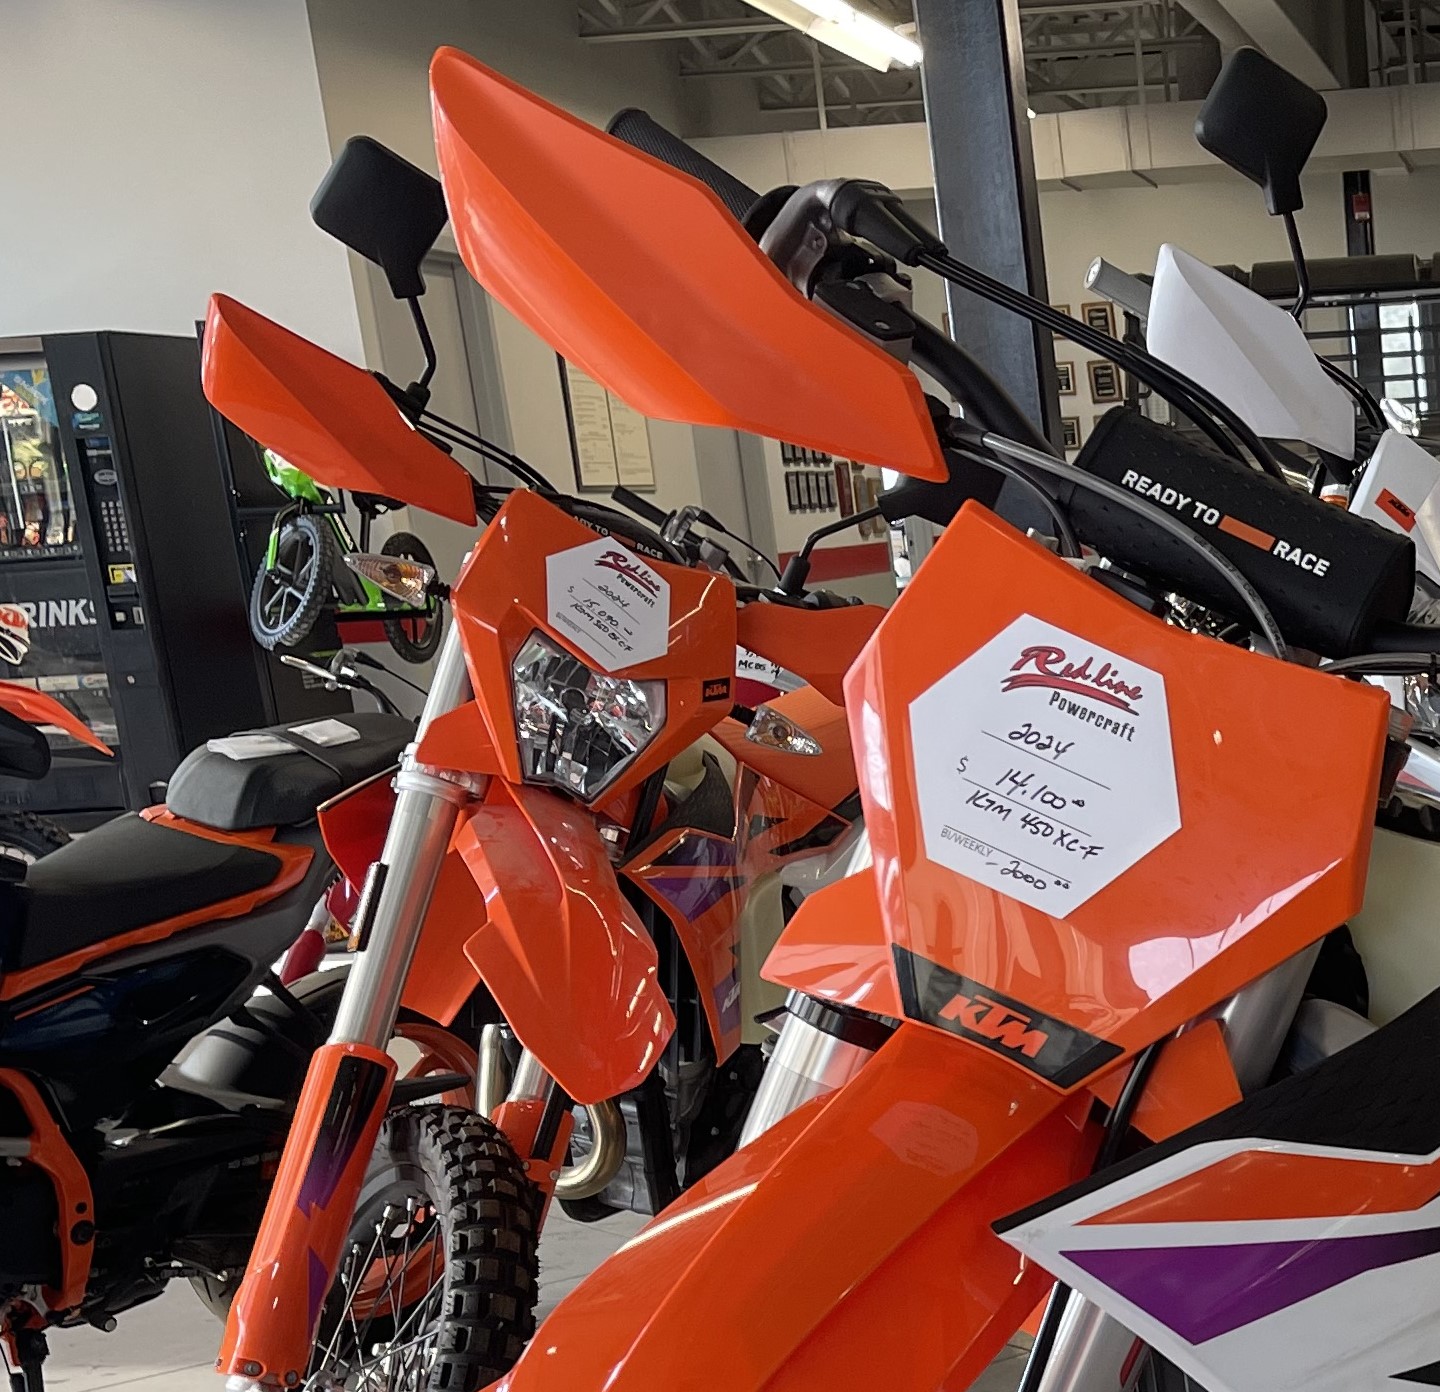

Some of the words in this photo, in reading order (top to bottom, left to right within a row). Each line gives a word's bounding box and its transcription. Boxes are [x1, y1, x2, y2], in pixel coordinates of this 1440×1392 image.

[1121, 469, 1192, 512] READY
[1192, 500, 1220, 526] TO
[1272, 539, 1331, 577] RACE
[595, 524, 609, 537] TO
[636, 542, 664, 560] RACE
[19, 598, 97, 628] RINK
[598, 584, 630, 608] 2024
[1048, 690, 1136, 742] Powercraft
[1008, 723, 1076, 760] 2024
[956, 755, 969, 775] $
[965, 789, 1013, 822] KTM
[1020, 812, 1055, 838] 450
[1053, 829, 1105, 860] XC-F
[938, 993, 1050, 1060] KTM
